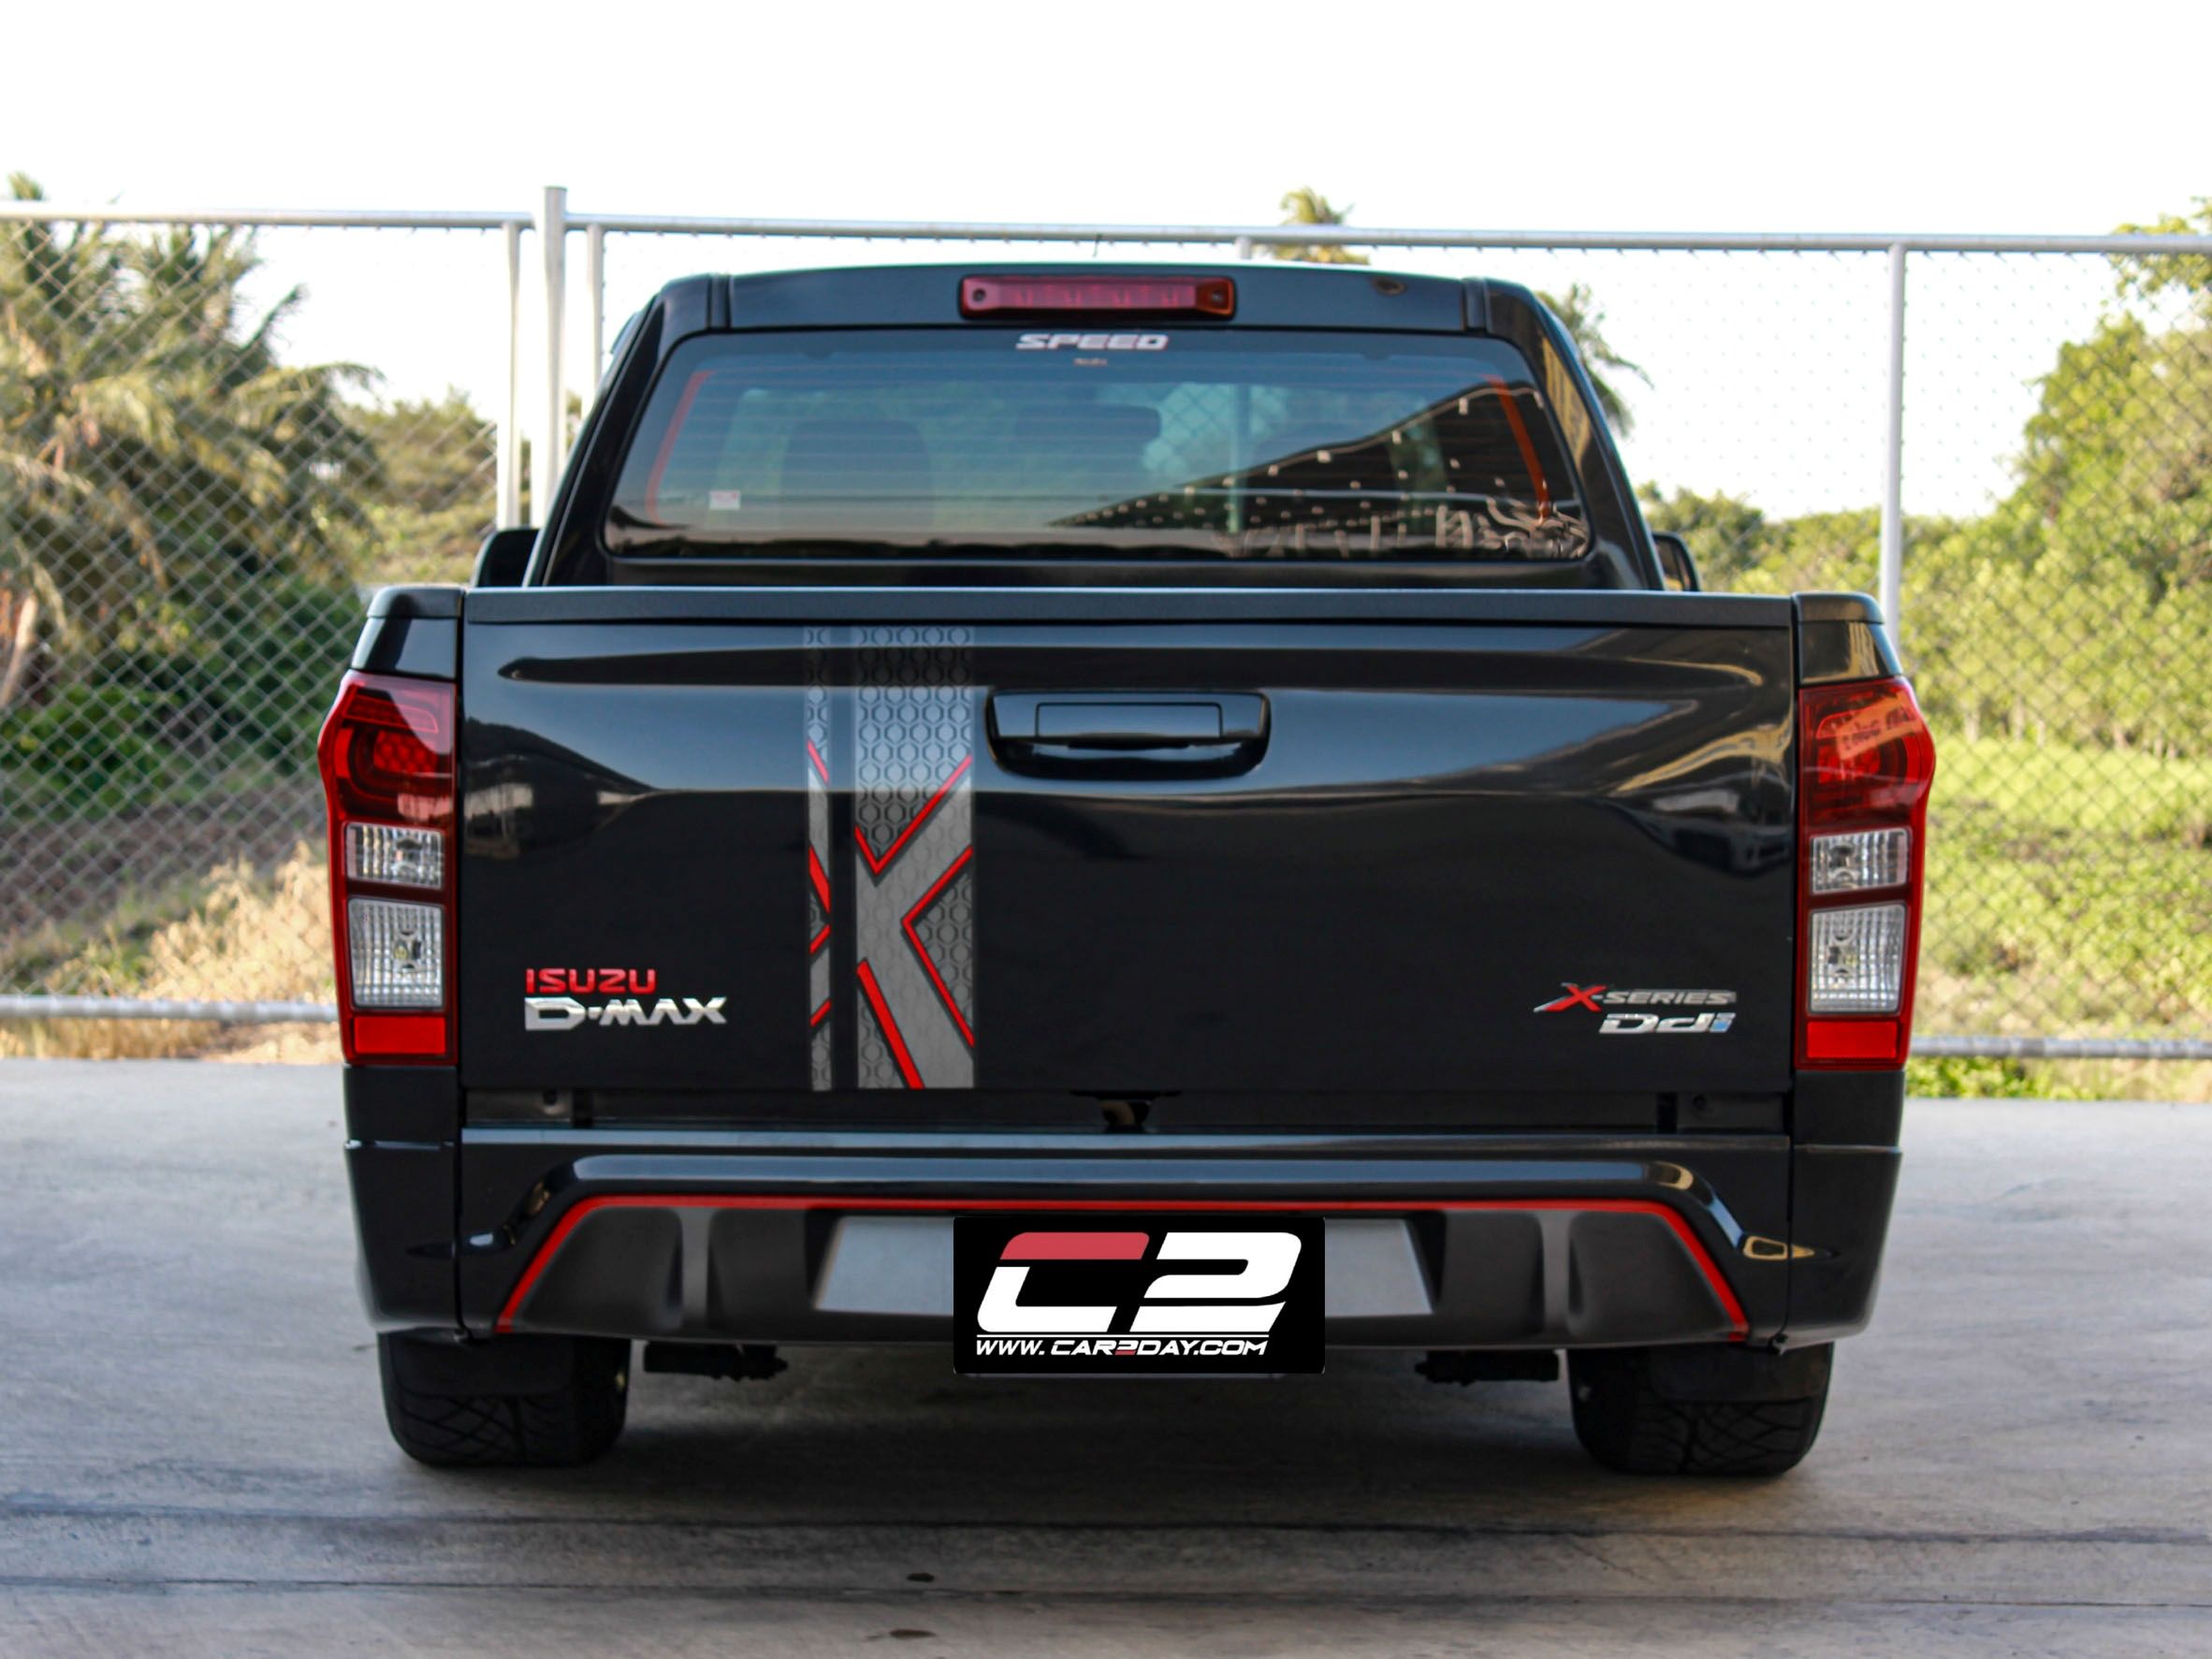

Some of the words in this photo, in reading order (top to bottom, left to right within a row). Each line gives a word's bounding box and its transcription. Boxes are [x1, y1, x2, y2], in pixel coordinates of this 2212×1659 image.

[1015, 333, 1169, 350] SPEED
[525, 968, 656, 995] ISUZU
[1534, 982, 1737, 1012] X-SERIES
[524, 997, 727, 1031] D-MAX
